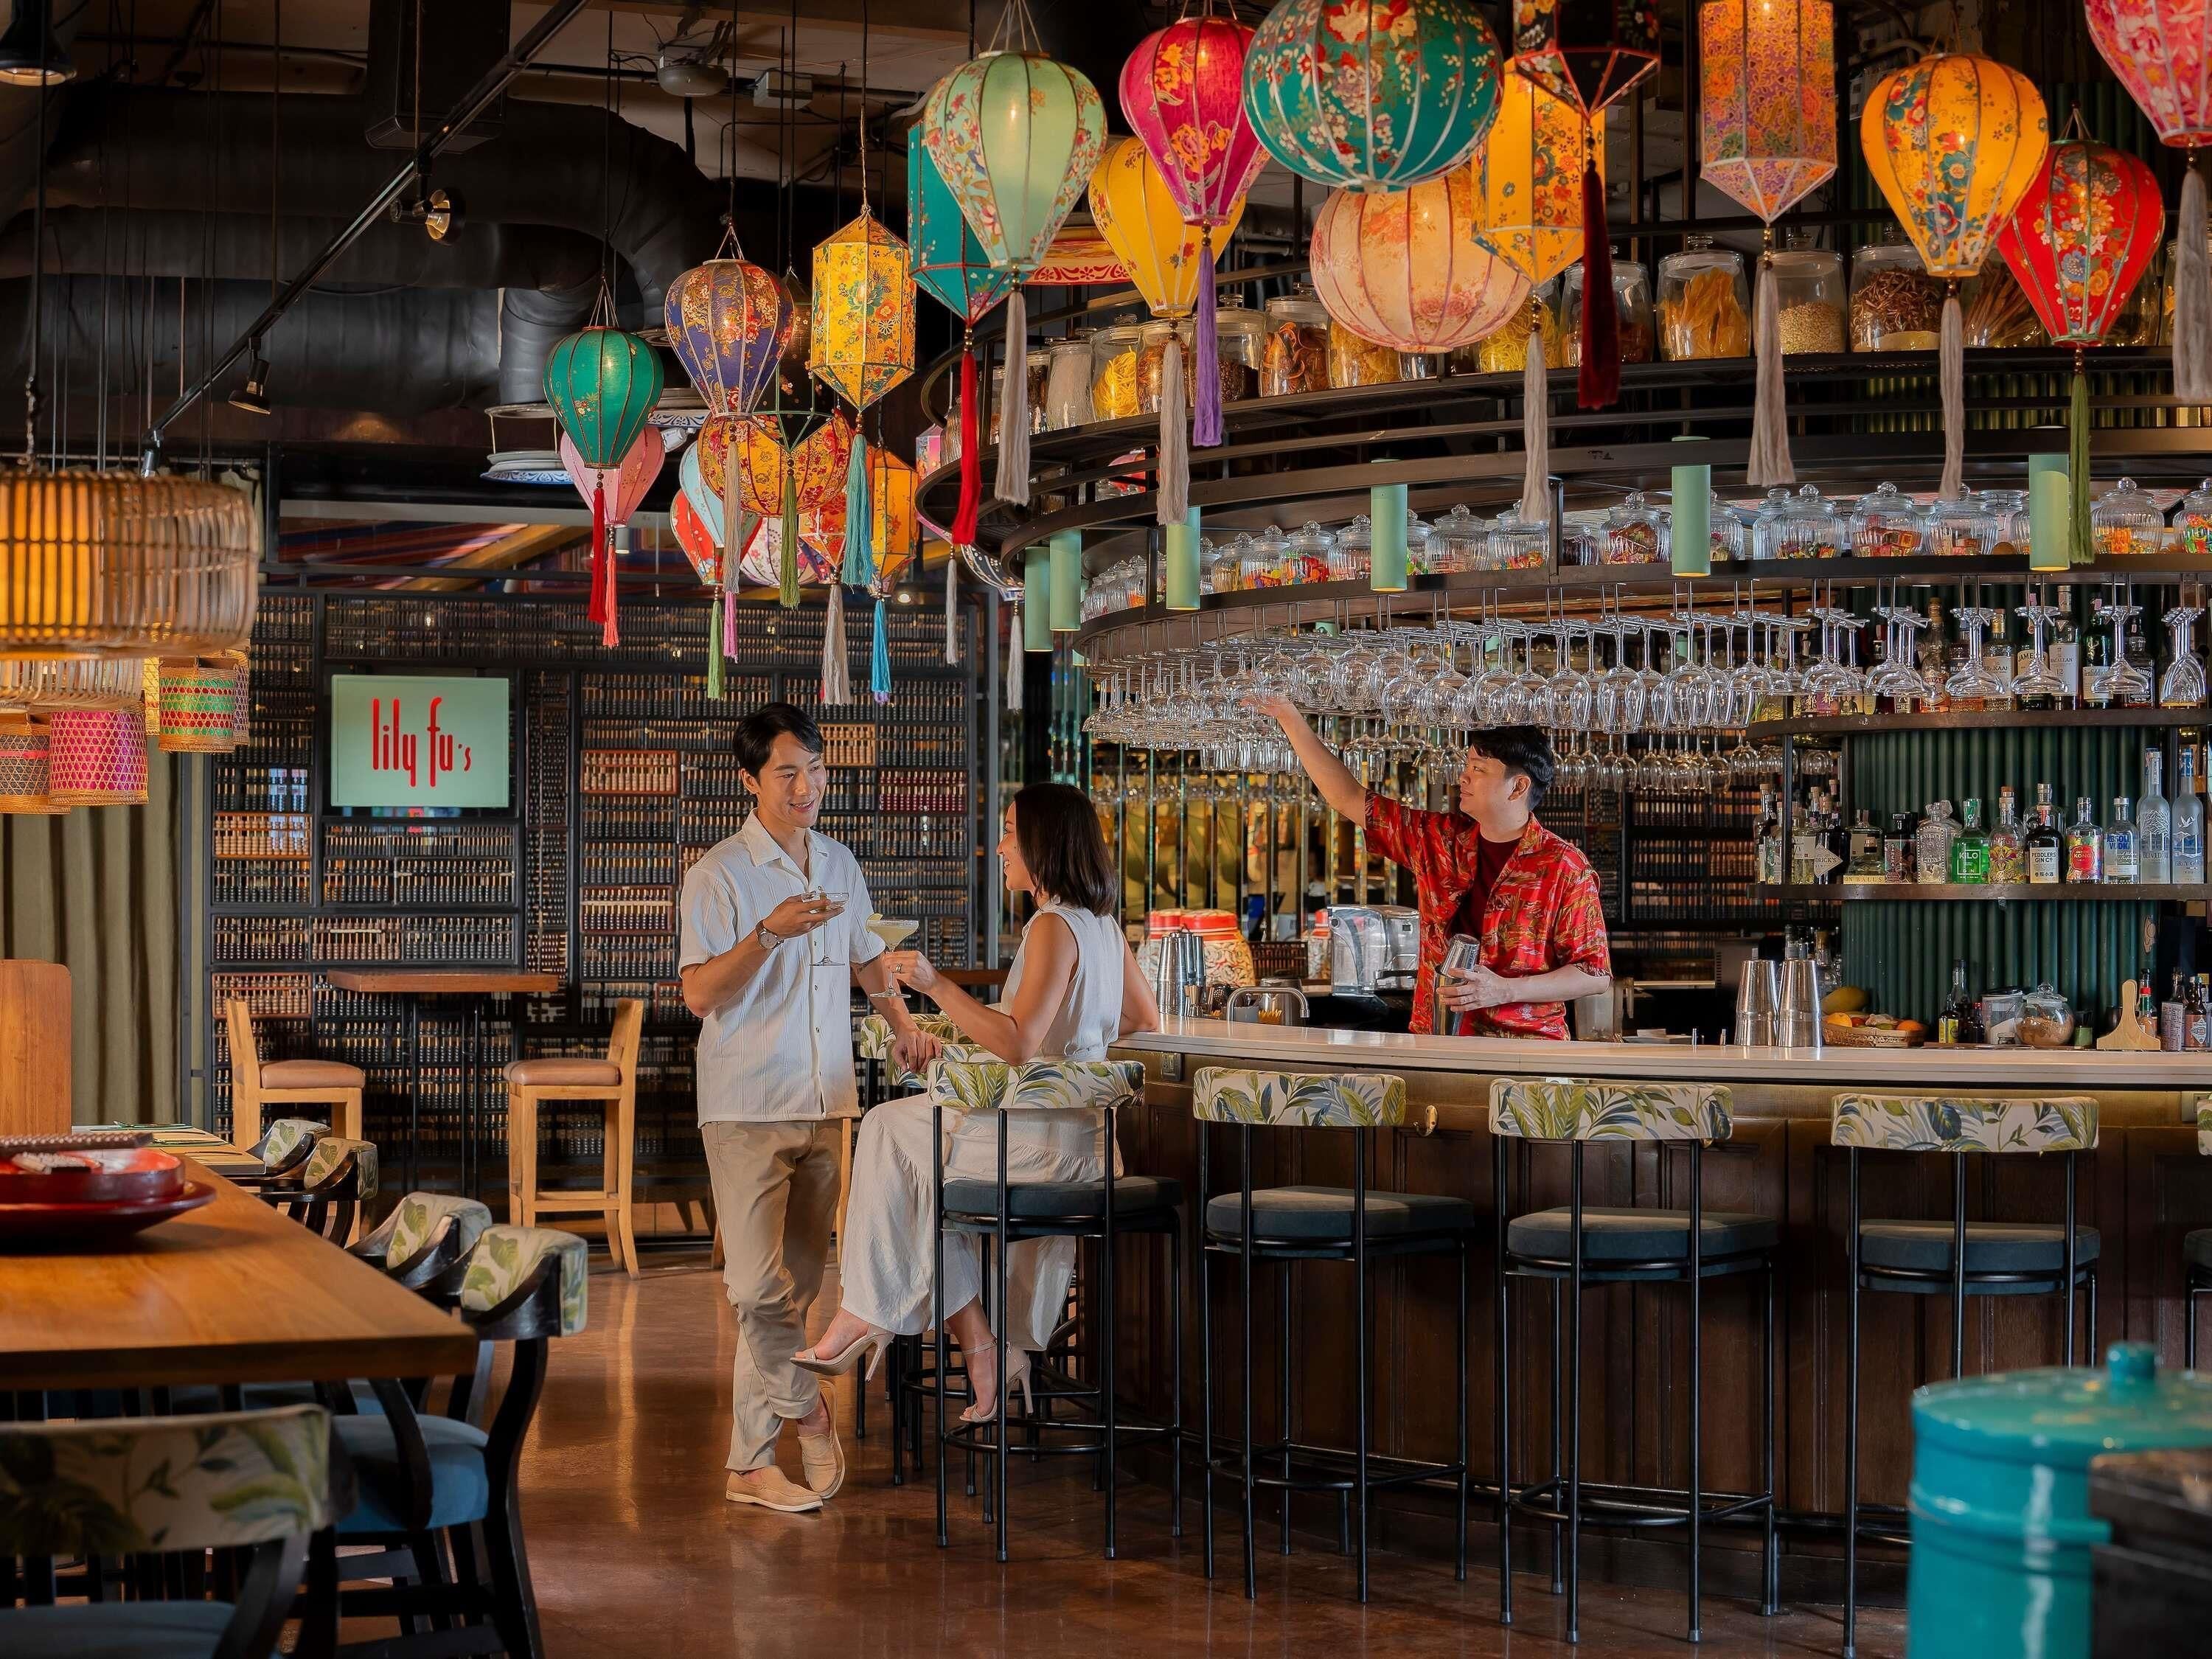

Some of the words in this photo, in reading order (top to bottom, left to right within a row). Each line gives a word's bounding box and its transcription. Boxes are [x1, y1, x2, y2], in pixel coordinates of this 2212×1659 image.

[2018, 653, 2046, 662] JAME
[372, 697, 417, 787] lily
[427, 697, 472, 787] fu's
